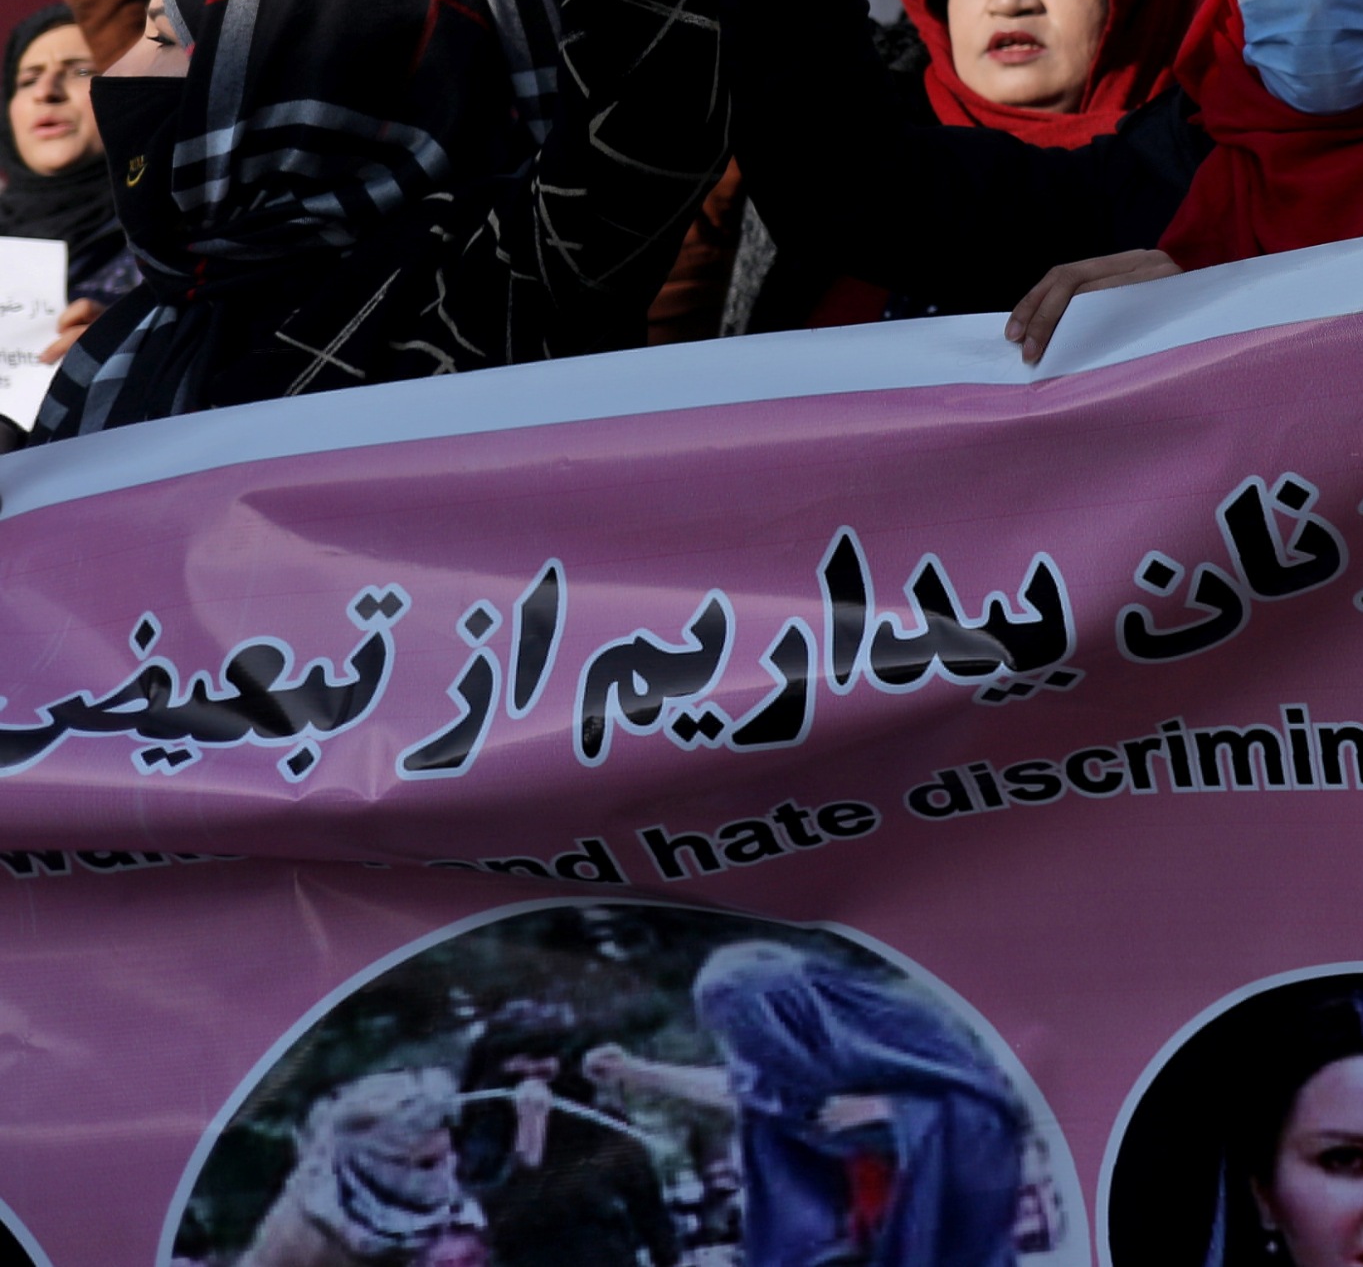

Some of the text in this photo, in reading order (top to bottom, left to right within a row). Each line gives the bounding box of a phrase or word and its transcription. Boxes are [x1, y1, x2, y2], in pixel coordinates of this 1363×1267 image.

[397, 559, 566, 779] از
[576, 526, 1087, 767] بیداریم
[636, 794, 883, 886] hate
